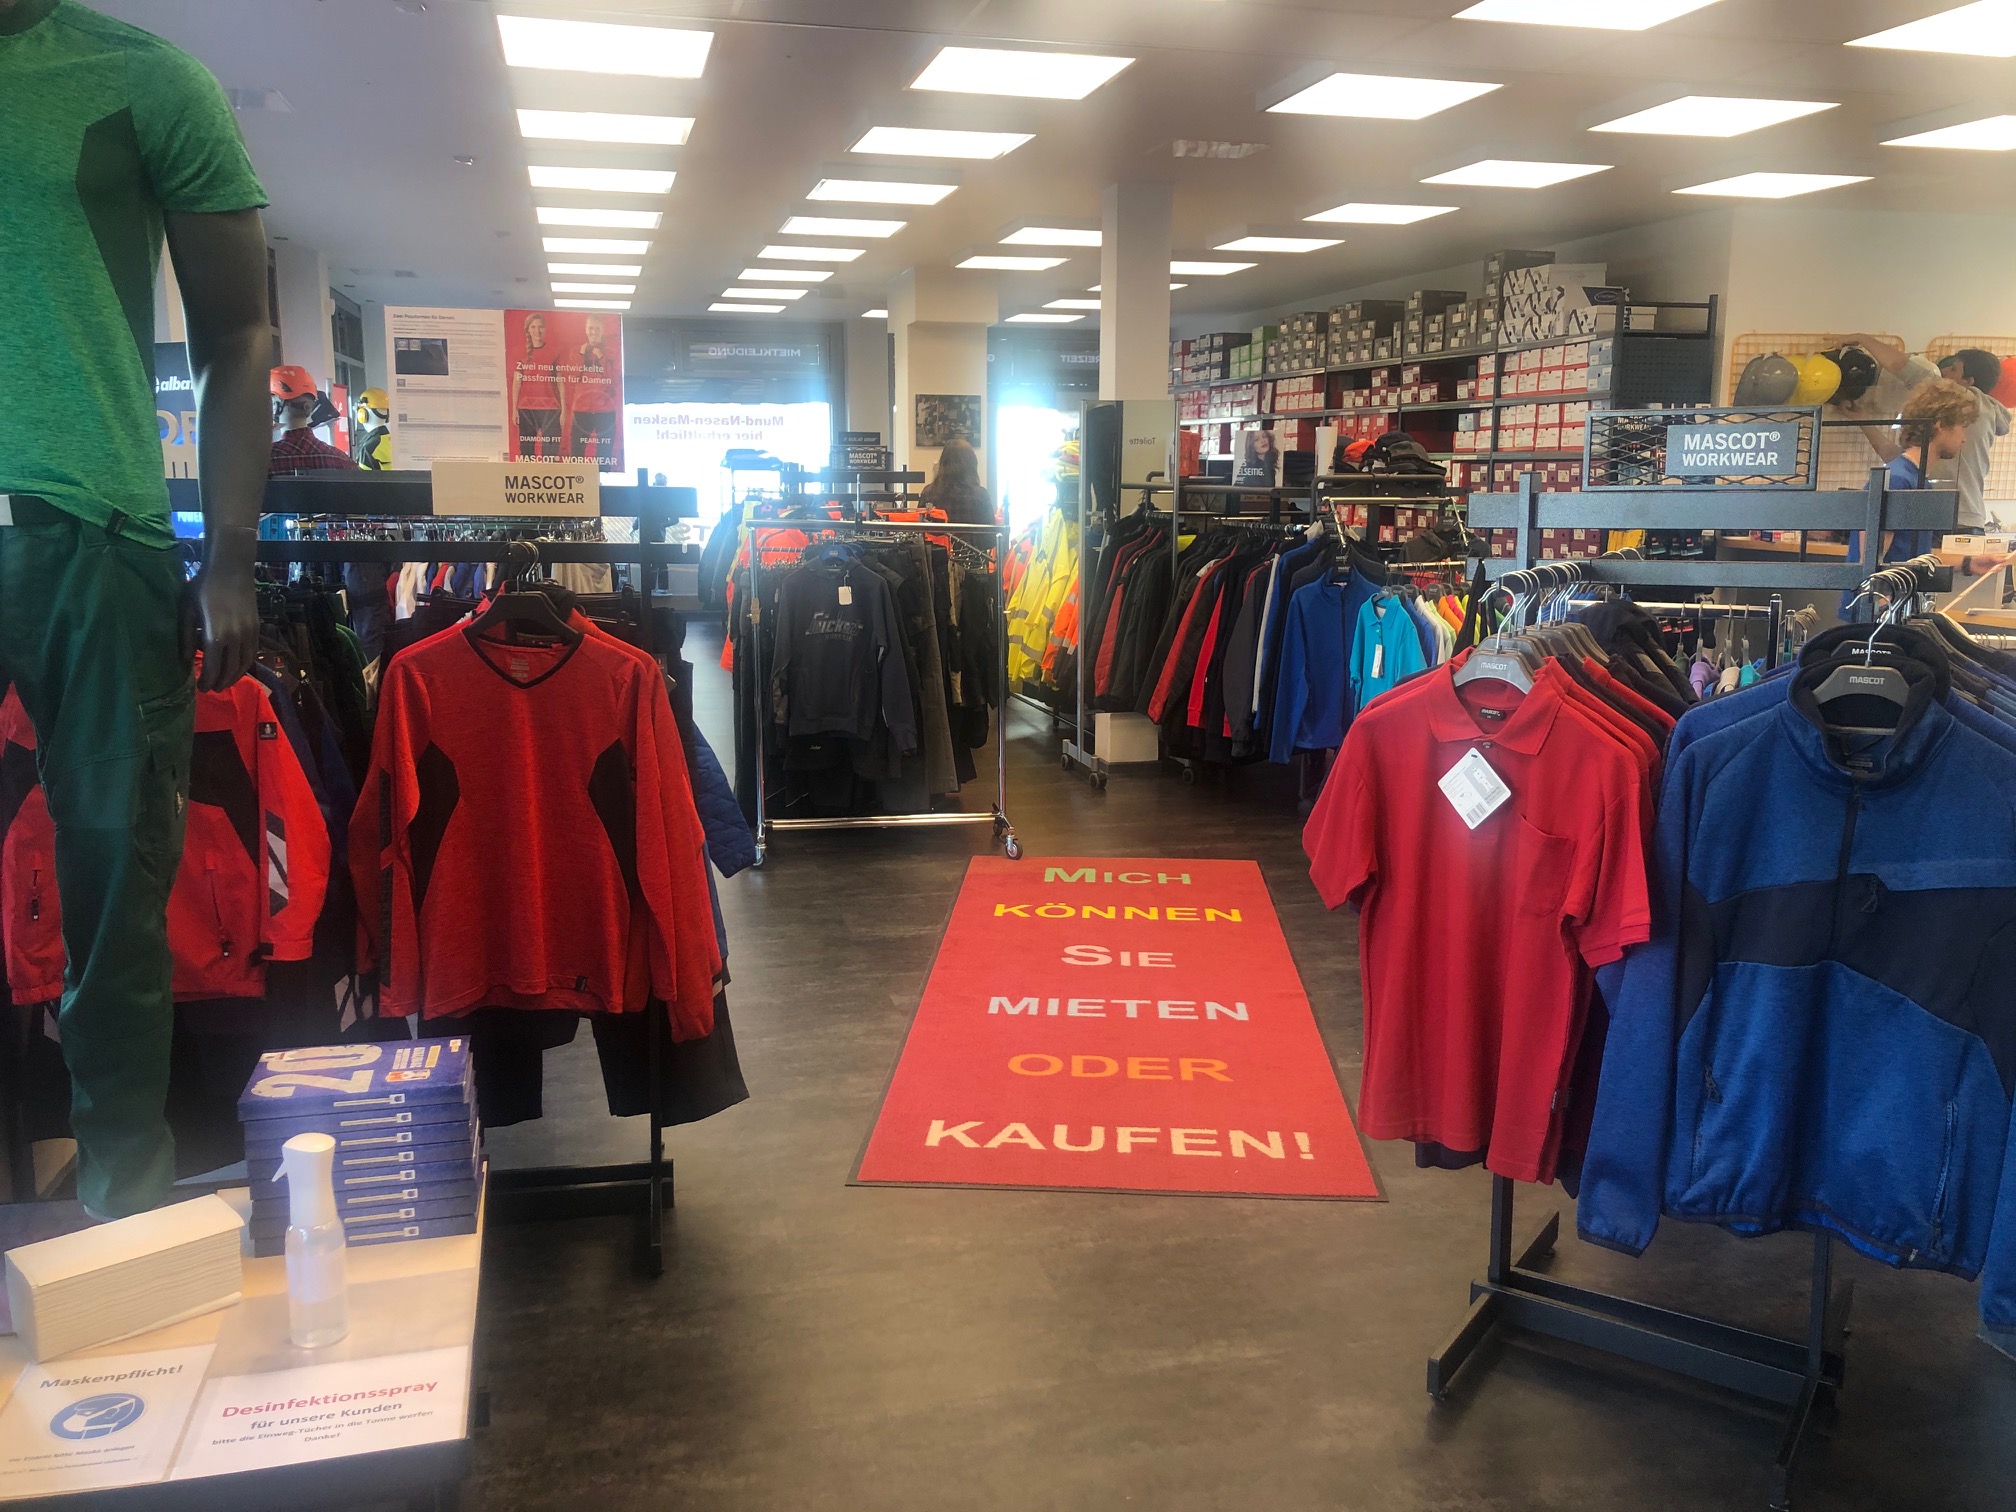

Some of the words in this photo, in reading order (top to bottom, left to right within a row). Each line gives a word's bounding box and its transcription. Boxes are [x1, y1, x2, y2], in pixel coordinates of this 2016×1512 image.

[516, 362, 536, 371] Zwei
[538, 363, 554, 371] neu
[556, 363, 604, 373] entwickelte
[517, 373, 566, 383] Passformen
[568, 374, 580, 383] für
[581, 375, 612, 385] Damen
[520, 435, 551, 443] DIAMOND
[1683, 431, 1781, 451] MASCOT®
[562, 456, 618, 466] WORKWEAR
[1682, 452, 1778, 467] WORKWEAR
[505, 492, 584, 504] WORKWEAR
[1480, 661, 1508, 671] MASCOT
[1849, 675, 1885, 685] MASCOT
[993, 903, 1242, 922] KÖNNEN
[987, 996, 1249, 1022] MIETEN
[1007, 1053, 1234, 1082] ODER
[924, 1119, 1315, 1161] KAUFEN!
[40, 1364, 184, 1389] Maskenpflicht!
[222, 1381, 438, 1418] Desinfektionsspray
[250, 1419, 275, 1430] für
[279, 1411, 336, 1426] unsere
[340, 1402, 403, 1418] Kunden
[212, 1438, 237, 1446] bitte
[239, 1434, 256, 1442] die
[258, 1424, 332, 1440] Einweg-Tücher
[347, 1419, 363, 1427] die
[366, 1415, 396, 1425] Tonne
[398, 1410, 434, 1420] werfen
